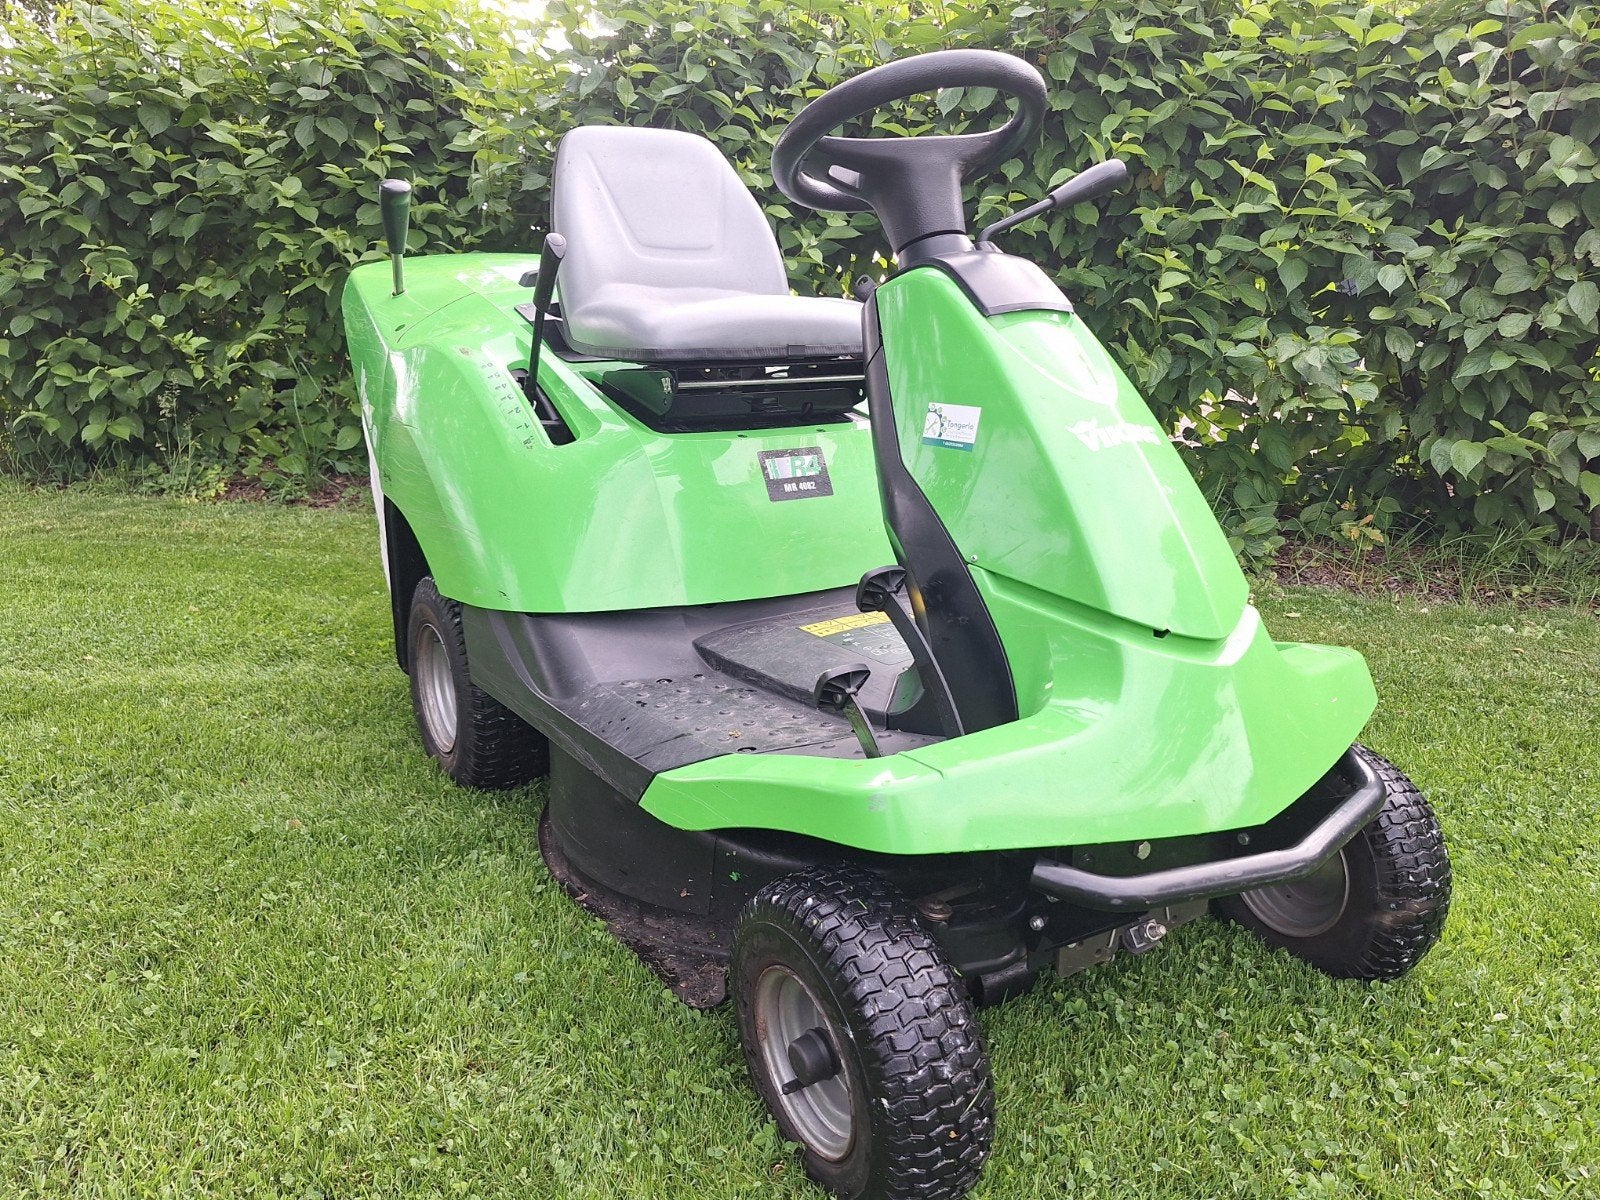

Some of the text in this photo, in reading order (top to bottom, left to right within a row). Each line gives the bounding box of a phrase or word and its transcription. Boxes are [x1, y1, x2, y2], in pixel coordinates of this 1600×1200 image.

[514, 406, 521, 414] 2
[783, 481, 817, 493] MR 4082
